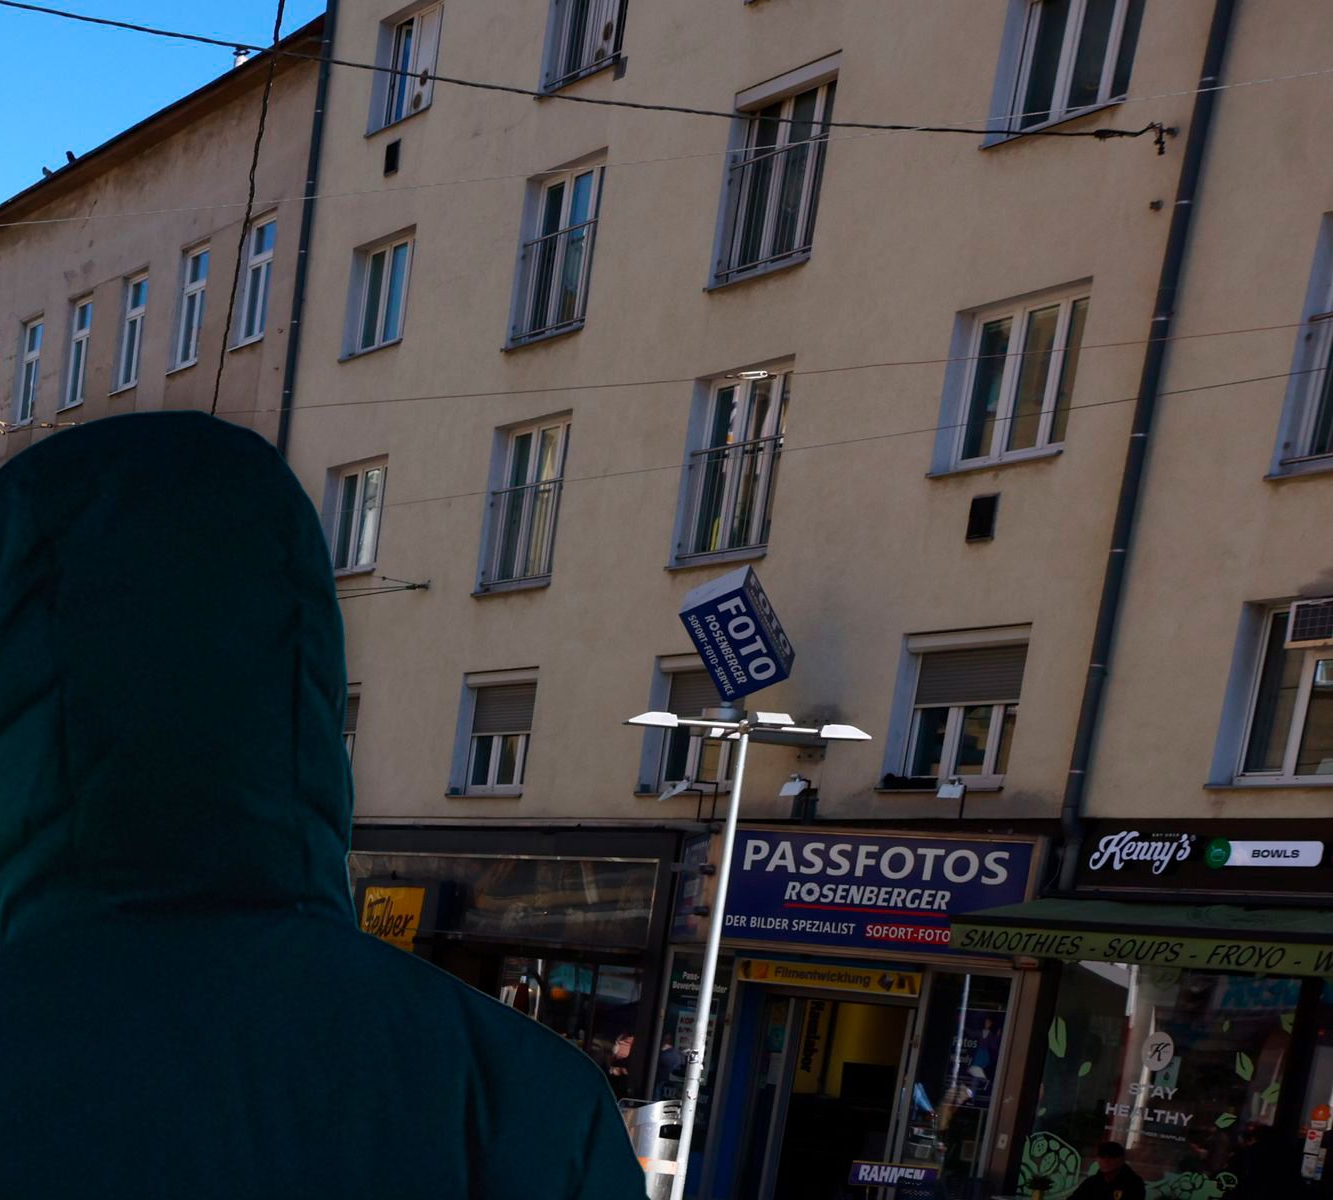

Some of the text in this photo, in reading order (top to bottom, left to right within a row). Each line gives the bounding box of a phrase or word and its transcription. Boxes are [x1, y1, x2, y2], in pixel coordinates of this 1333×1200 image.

[687, 614, 735, 697] SOFORT-FOTO-SERVICE
[705, 614, 748, 684] ROSENBERGER
[717, 596, 776, 681] FOTO
[742, 839, 1010, 886] PASSFOTOS
[1089, 830, 1192, 876] Kenny's
[1251, 849, 1300, 859] BOWLS
[784, 881, 951, 911] ROSENBERGER
[366, 895, 414, 937] Felber
[725, 914, 747, 928] DER
[750, 916, 789, 931] BILDER
[791, 919, 856, 935] SPEZIALIST
[960, 929, 1083, 957] SMOOTHIES
[1103, 937, 1184, 963] SOUPS
[1205, 945, 1286, 969] FROYO
[774, 966, 871, 988] Filmentwicklung
[1128, 1082, 1179, 1101] STAY
[1105, 1102, 1195, 1128] HEALTHY
[858, 1164, 926, 1183] RAHMEN
